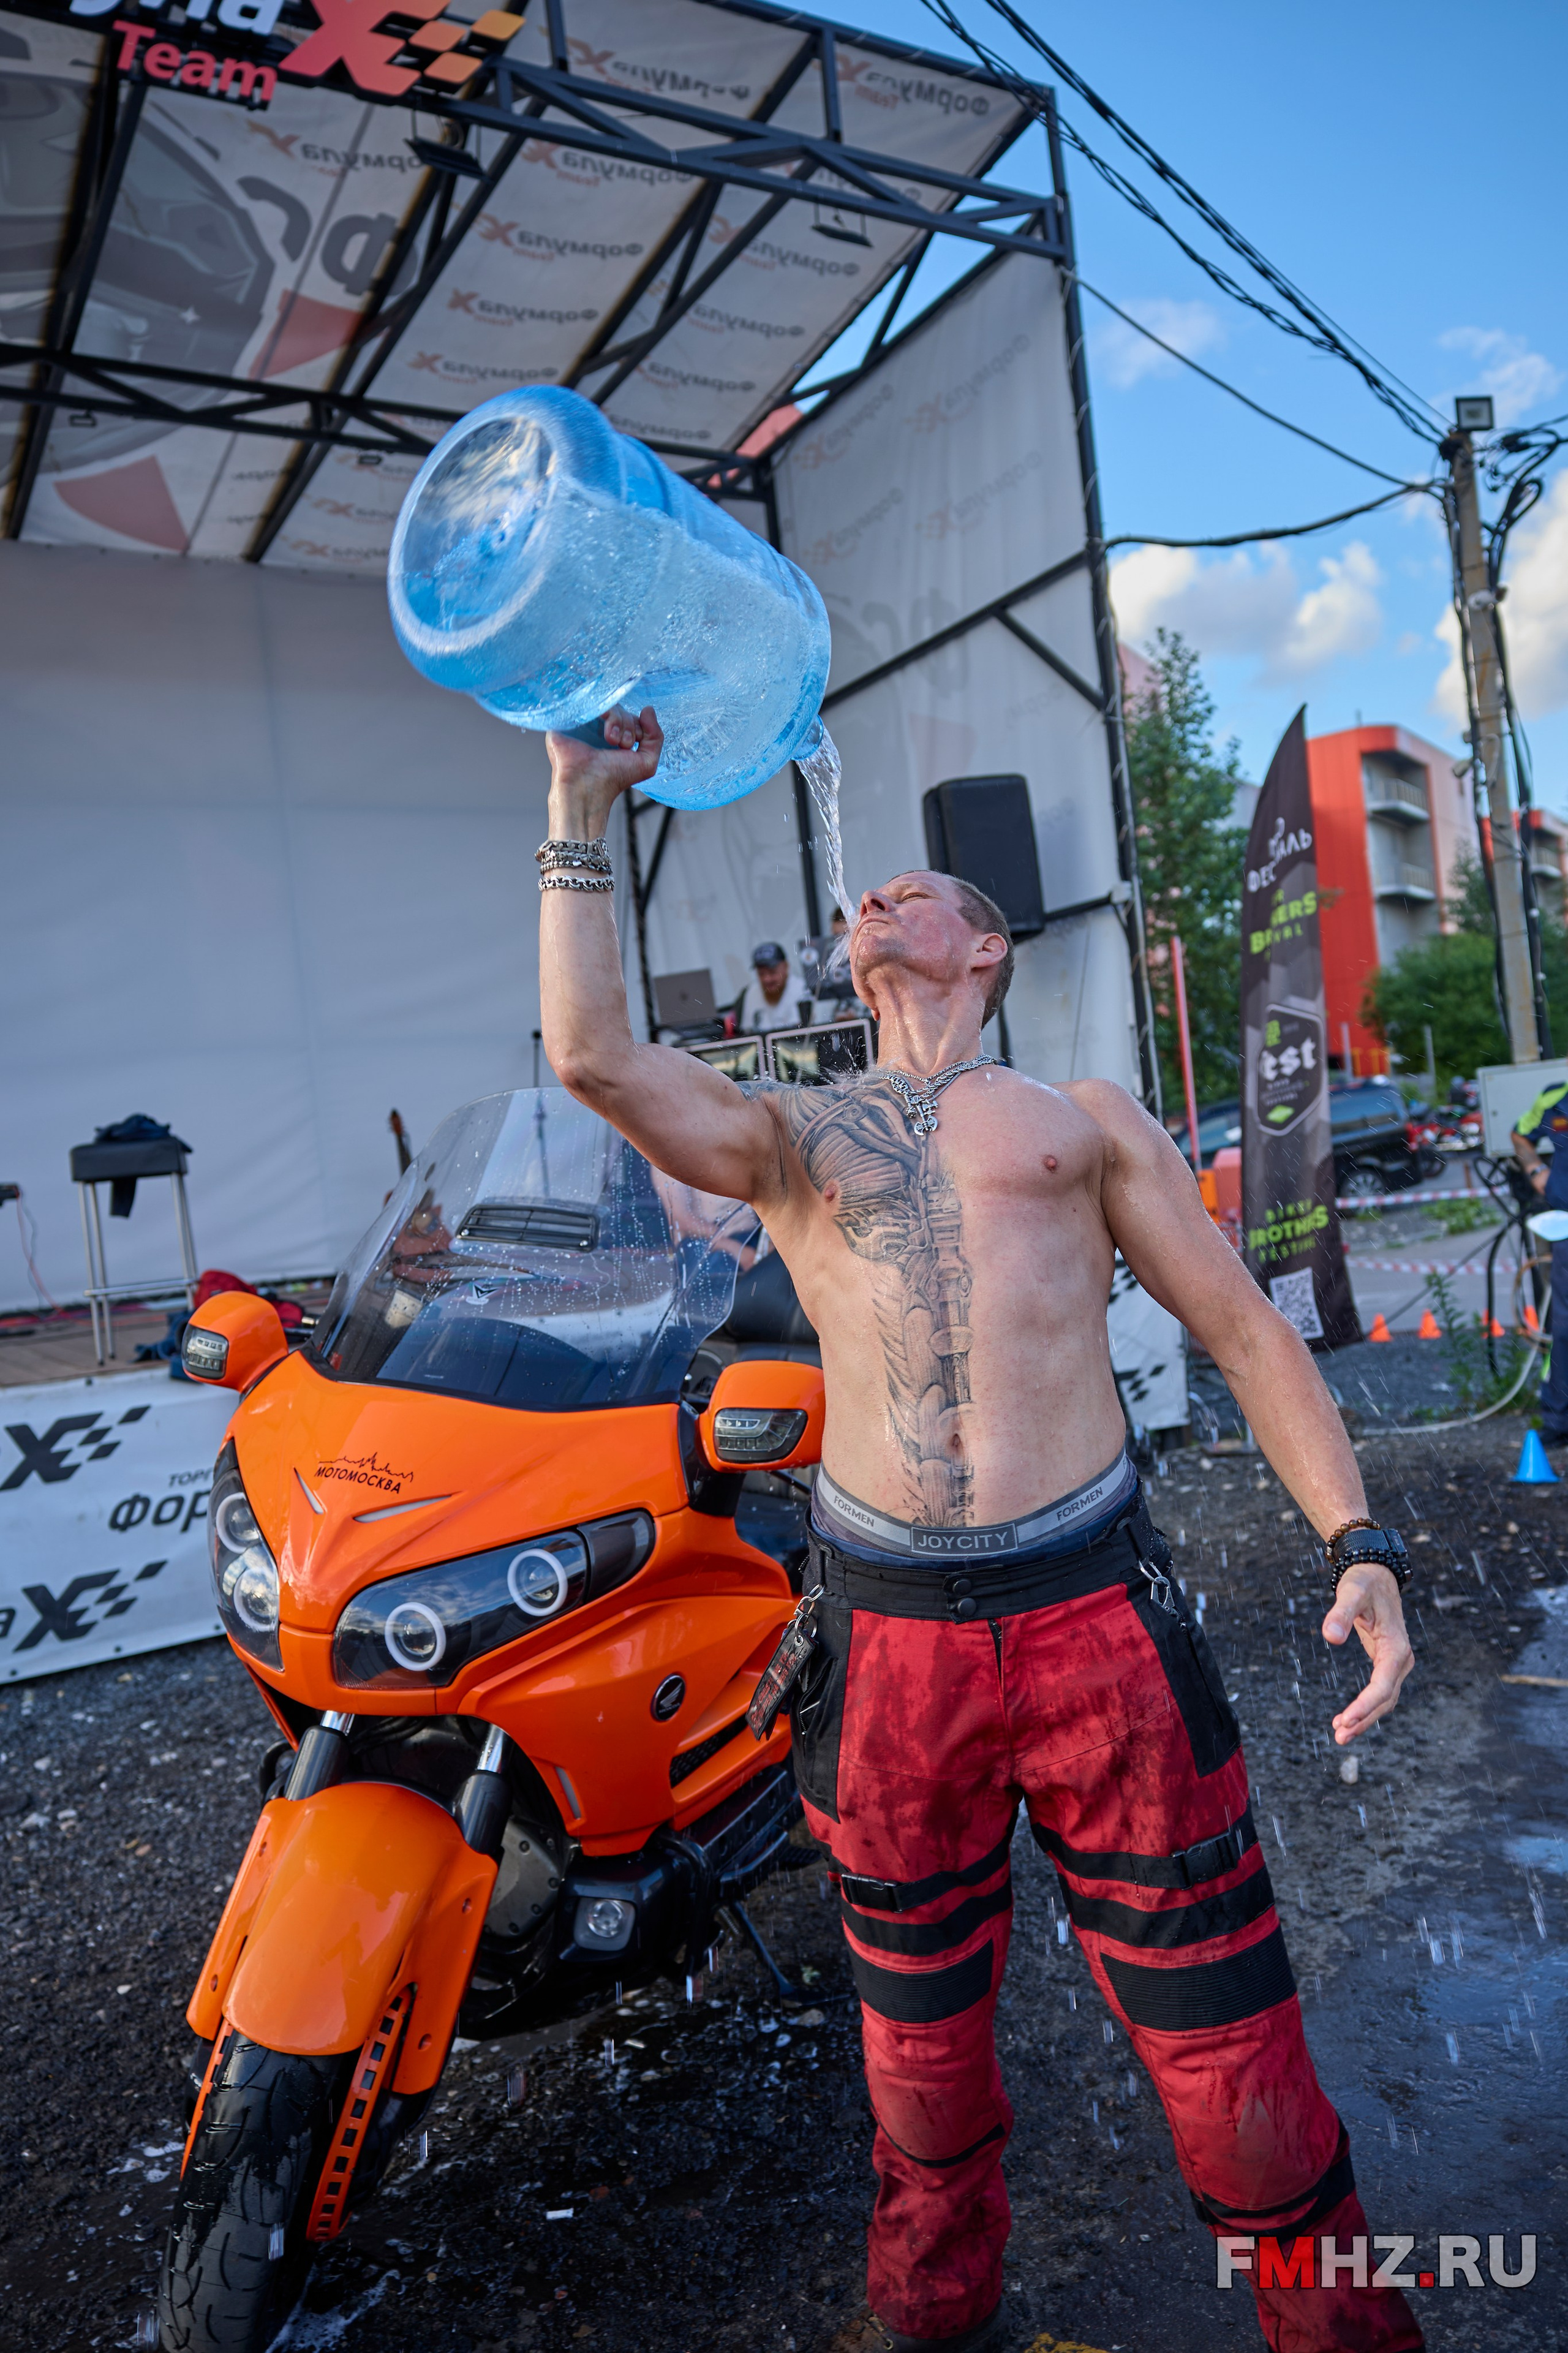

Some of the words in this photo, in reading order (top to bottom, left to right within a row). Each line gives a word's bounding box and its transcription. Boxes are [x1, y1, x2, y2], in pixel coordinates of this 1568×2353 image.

[113, 20, 278, 102] Team
[314, 1466, 401, 1495] МОТОМОСКВА
[833, 1494, 875, 1528] FORMEN
[1056, 1486, 1104, 1522] FORMEN
[918, 1532, 1009, 1550] JOYCITY
